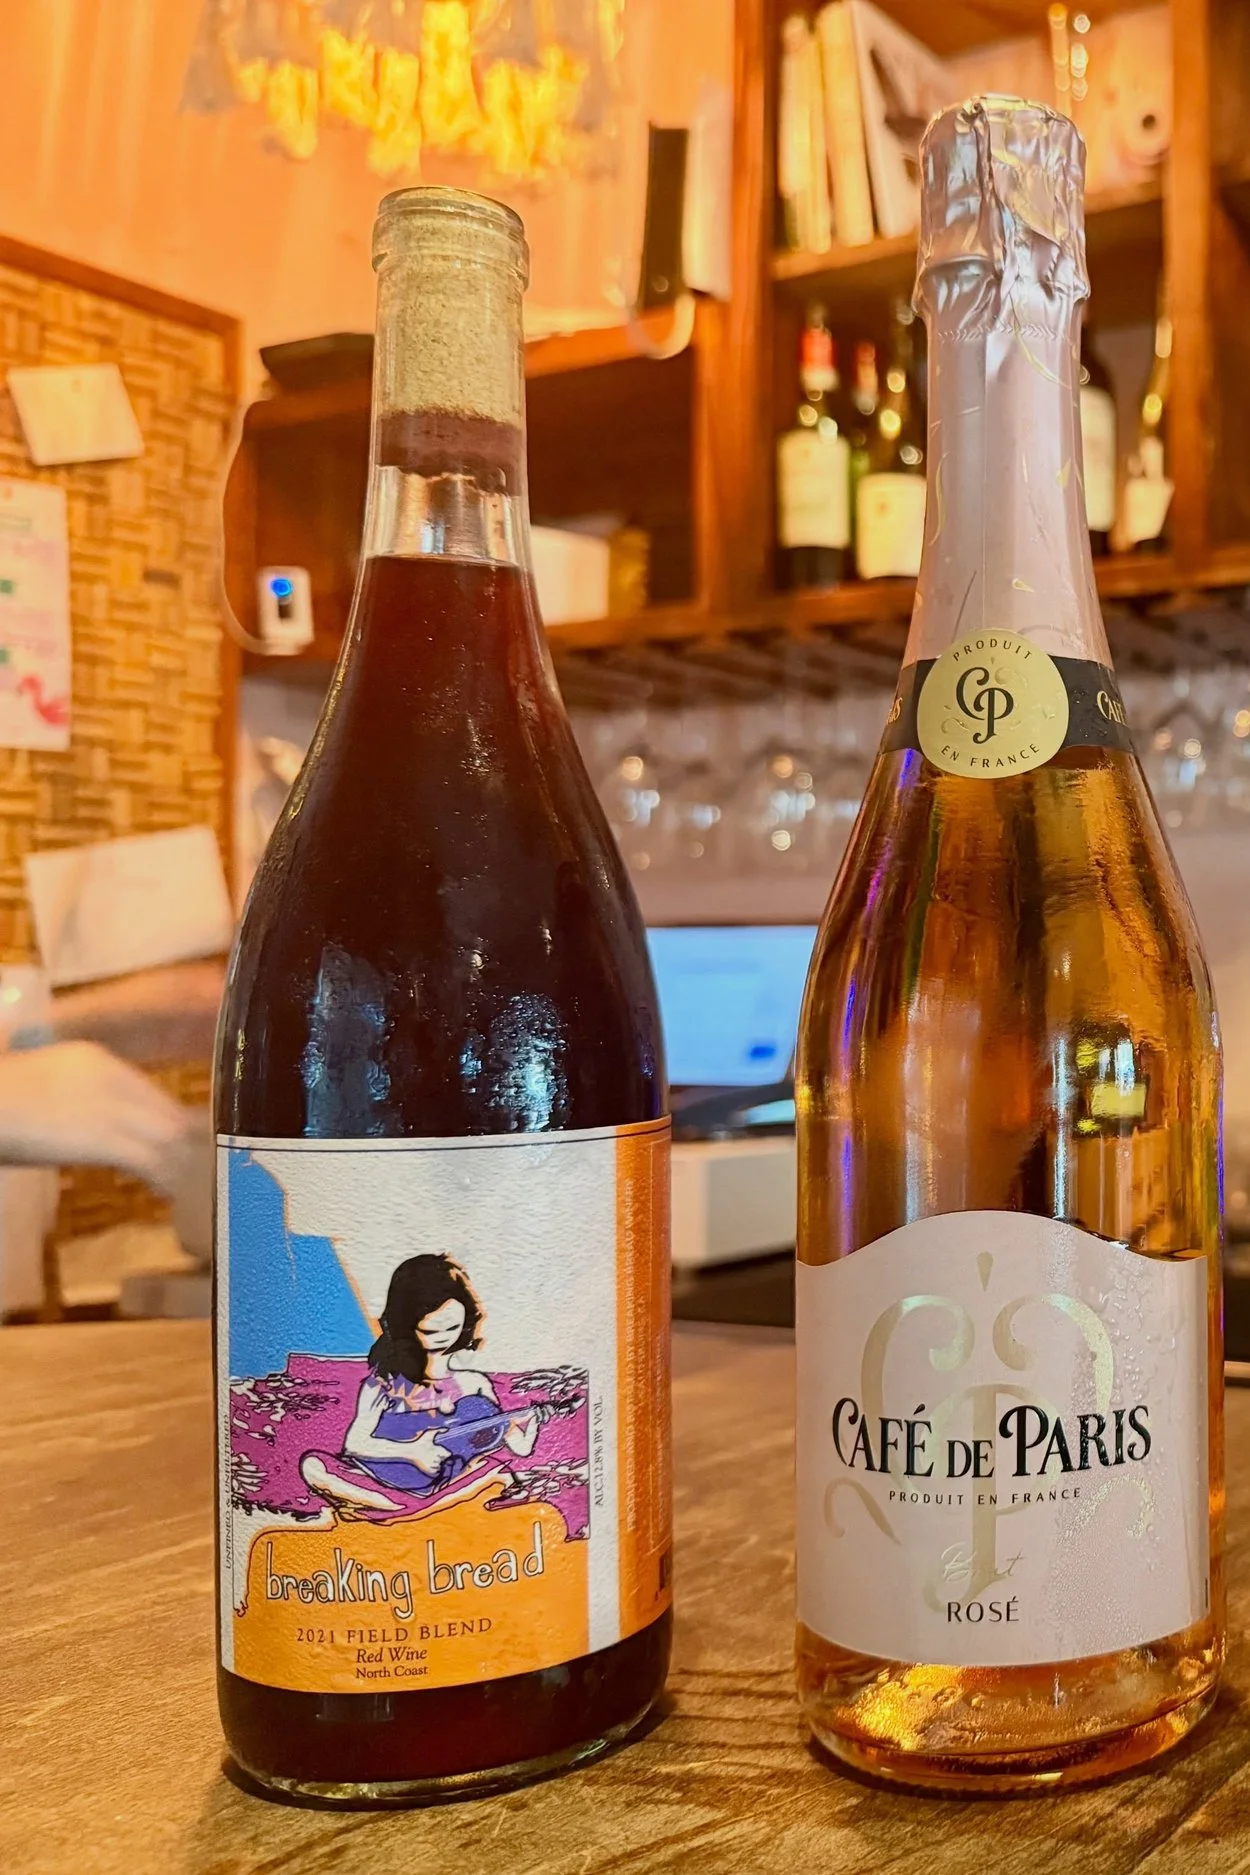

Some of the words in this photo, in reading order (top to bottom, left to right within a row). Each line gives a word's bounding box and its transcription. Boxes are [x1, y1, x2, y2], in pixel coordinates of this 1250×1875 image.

[952, 638, 1033, 662] PRODUIT
[941, 744, 960, 761] EN
[970, 743, 1040, 768] FRANCE
[594, 1430, 603, 1443] BY
[832, 1397, 933, 1478] CAFÉ
[947, 1440, 994, 1479] DE
[998, 1404, 1152, 1477] PARIS
[223, 1414, 231, 1494] UNFILTERED
[889, 1490, 964, 1505] PRODUIT
[977, 1493, 999, 1504] EN
[1011, 1487, 1082, 1504] FRANCE
[224, 1511, 232, 1570] UNFINED
[266, 1541, 414, 1619] breaking
[426, 1521, 544, 1594] bread
[947, 1595, 1019, 1623] ROSÉ
[297, 1628, 335, 1643] 2021
[347, 1628, 408, 1643] FIELD
[420, 1617, 493, 1640] BLEND
[356, 1648, 384, 1664] Red
[389, 1646, 428, 1662] Wine
[356, 1667, 391, 1679] North
[394, 1665, 428, 1677] Coast
